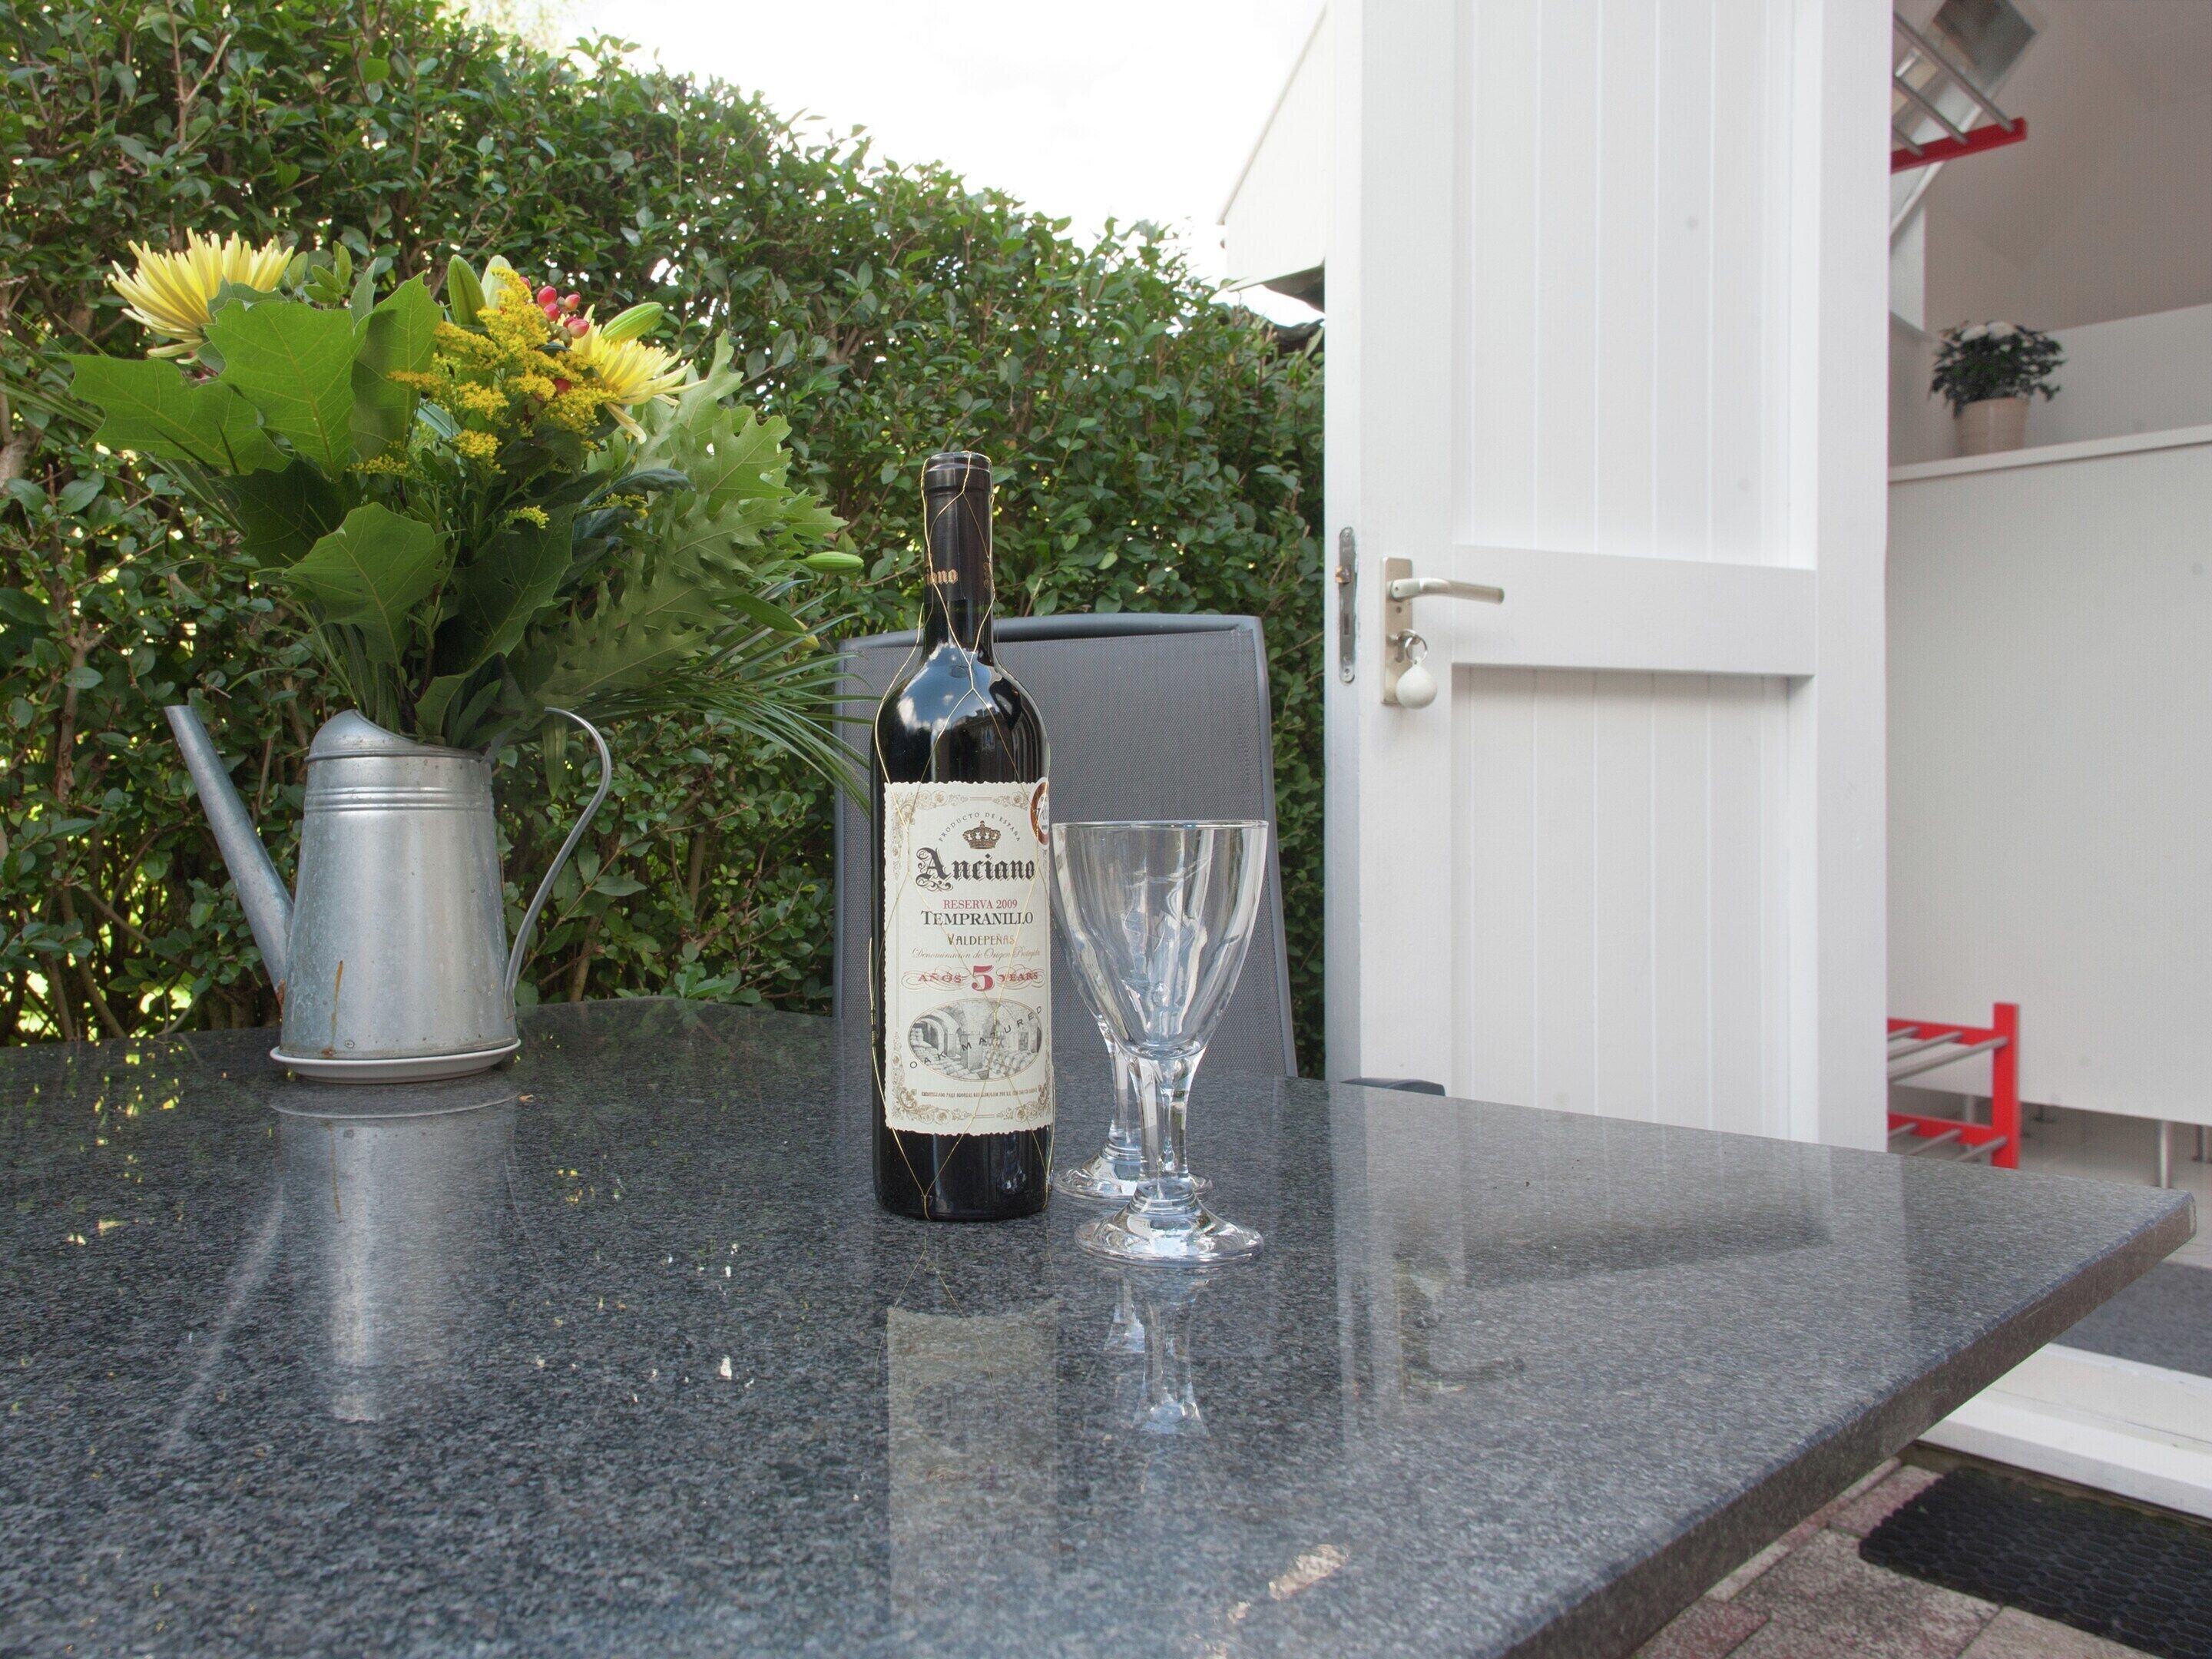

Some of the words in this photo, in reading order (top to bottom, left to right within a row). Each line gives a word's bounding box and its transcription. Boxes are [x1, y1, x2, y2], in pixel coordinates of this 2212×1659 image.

[926, 569, 959, 585] iano
[939, 812, 980, 842] PRODUCTO
[998, 816, 1021, 842] ESPAÑA
[916, 847, 1035, 892] Anciano
[943, 899, 993, 909] RESERVA
[996, 899, 1018, 909] 2009
[921, 910, 1034, 926] TEMPRANILLO
[947, 933, 1015, 945] VALDEPEÑAS
[918, 971, 962, 984] AÑOS
[971, 965, 995, 992] 5
[998, 971, 1038, 983] YEARS
[909, 1051, 948, 1069] OAK
